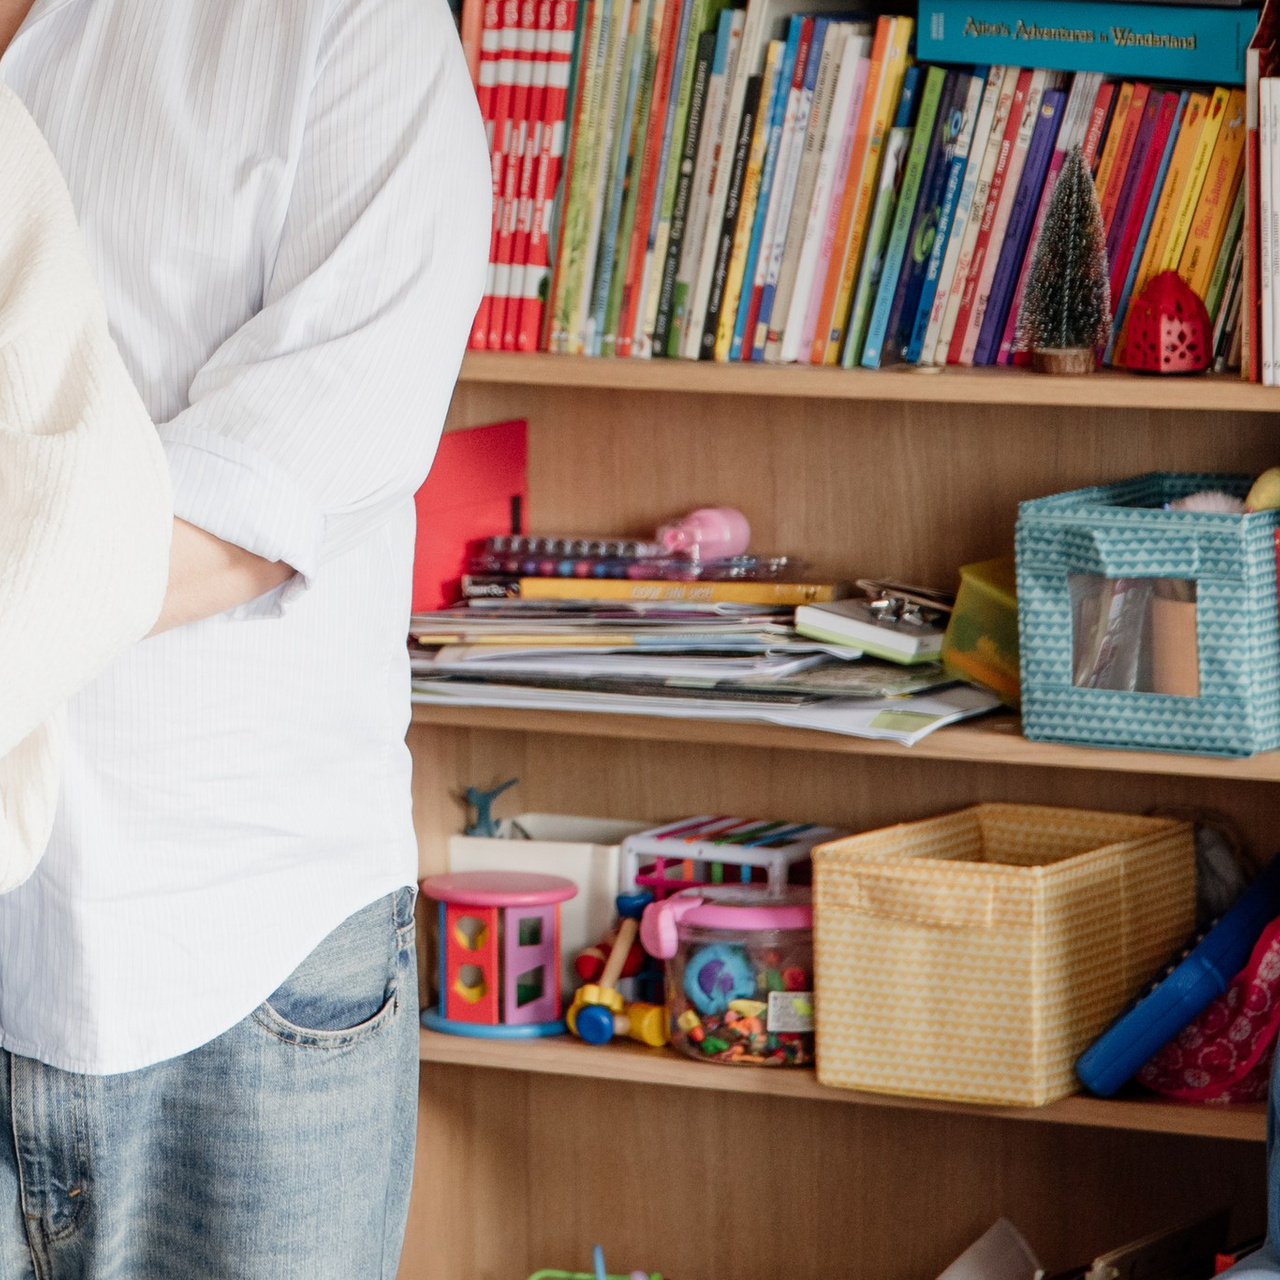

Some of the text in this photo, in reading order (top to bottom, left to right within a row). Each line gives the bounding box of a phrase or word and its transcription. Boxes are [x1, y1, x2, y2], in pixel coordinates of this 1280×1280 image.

[963, 16, 1010, 37] Alice's
[1012, 20, 1095, 44] Adventures
[1110, 26, 1197, 50] Wonderland
